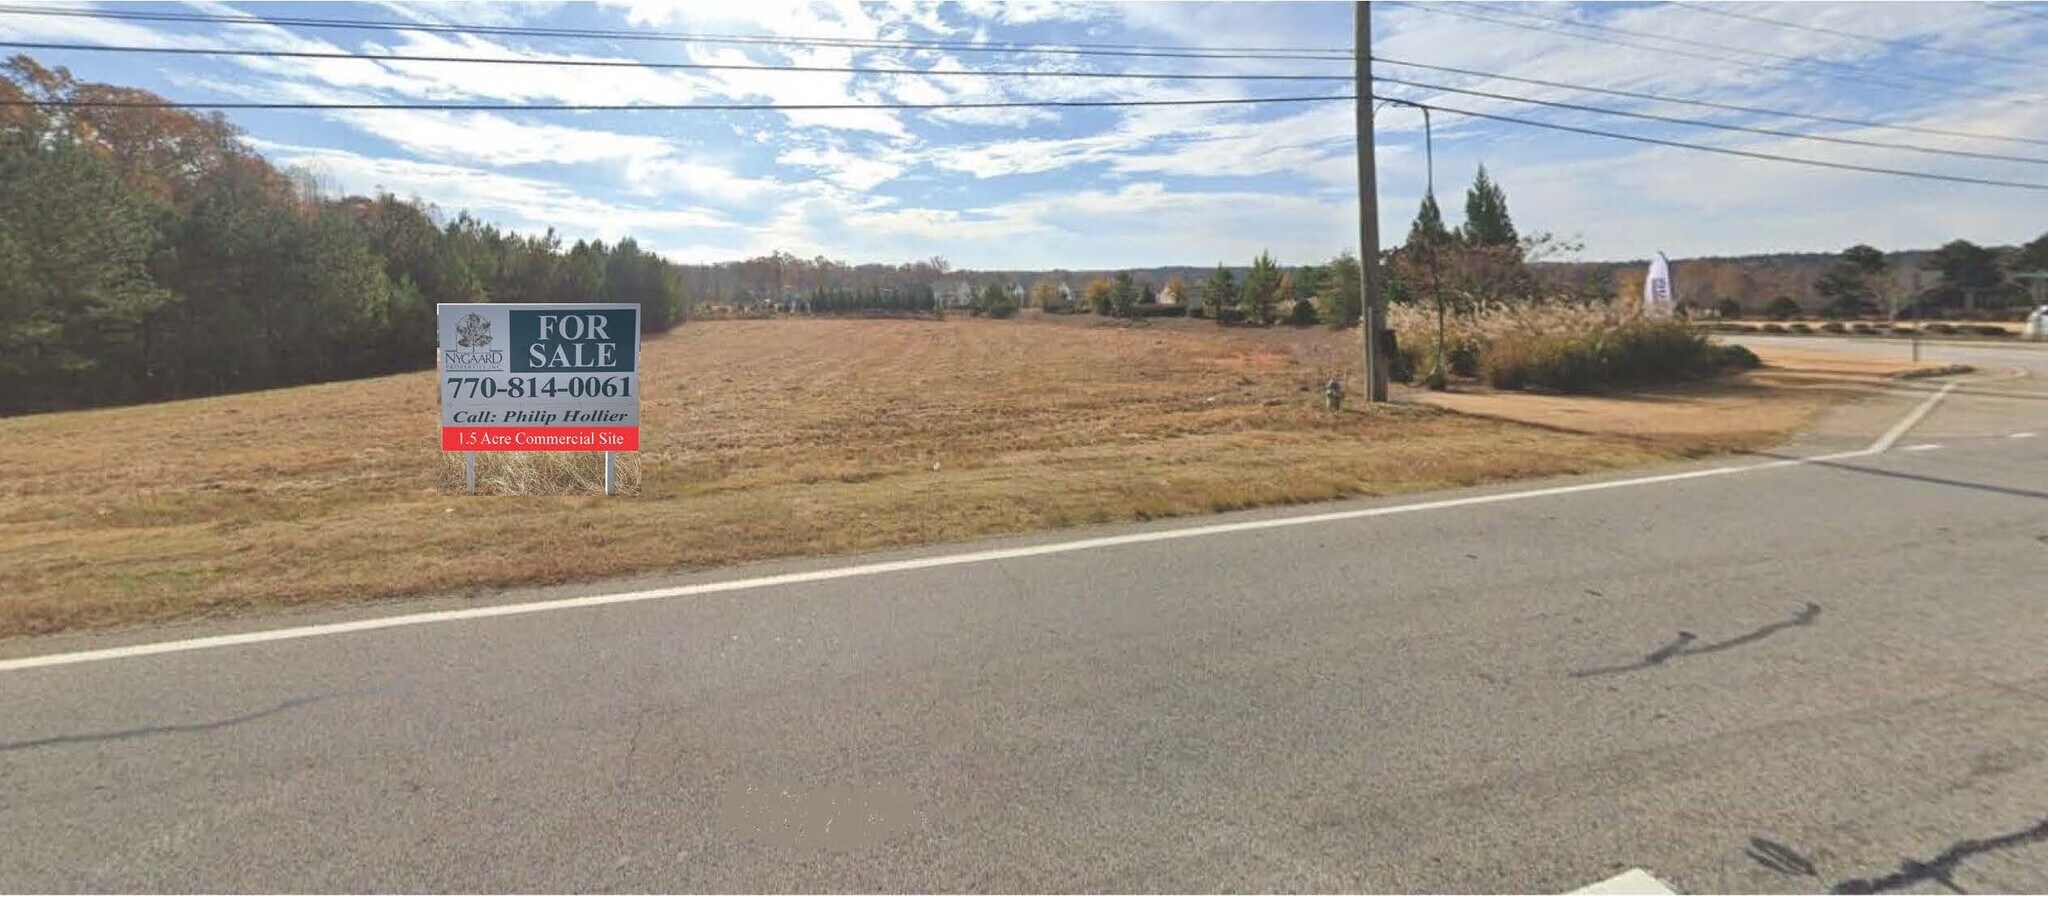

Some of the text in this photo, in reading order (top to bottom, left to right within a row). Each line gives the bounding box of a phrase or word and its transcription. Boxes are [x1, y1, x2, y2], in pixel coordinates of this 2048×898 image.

[538, 315, 610, 340] FOR
[445, 352, 503, 364] NYGAARD
[529, 343, 617, 368] SALE
[447, 377, 632, 398] 770-814-0061
[453, 410, 628, 425] Call: Philip Hollier
[459, 432, 624, 445] 1.5 Acre Commercial Site
